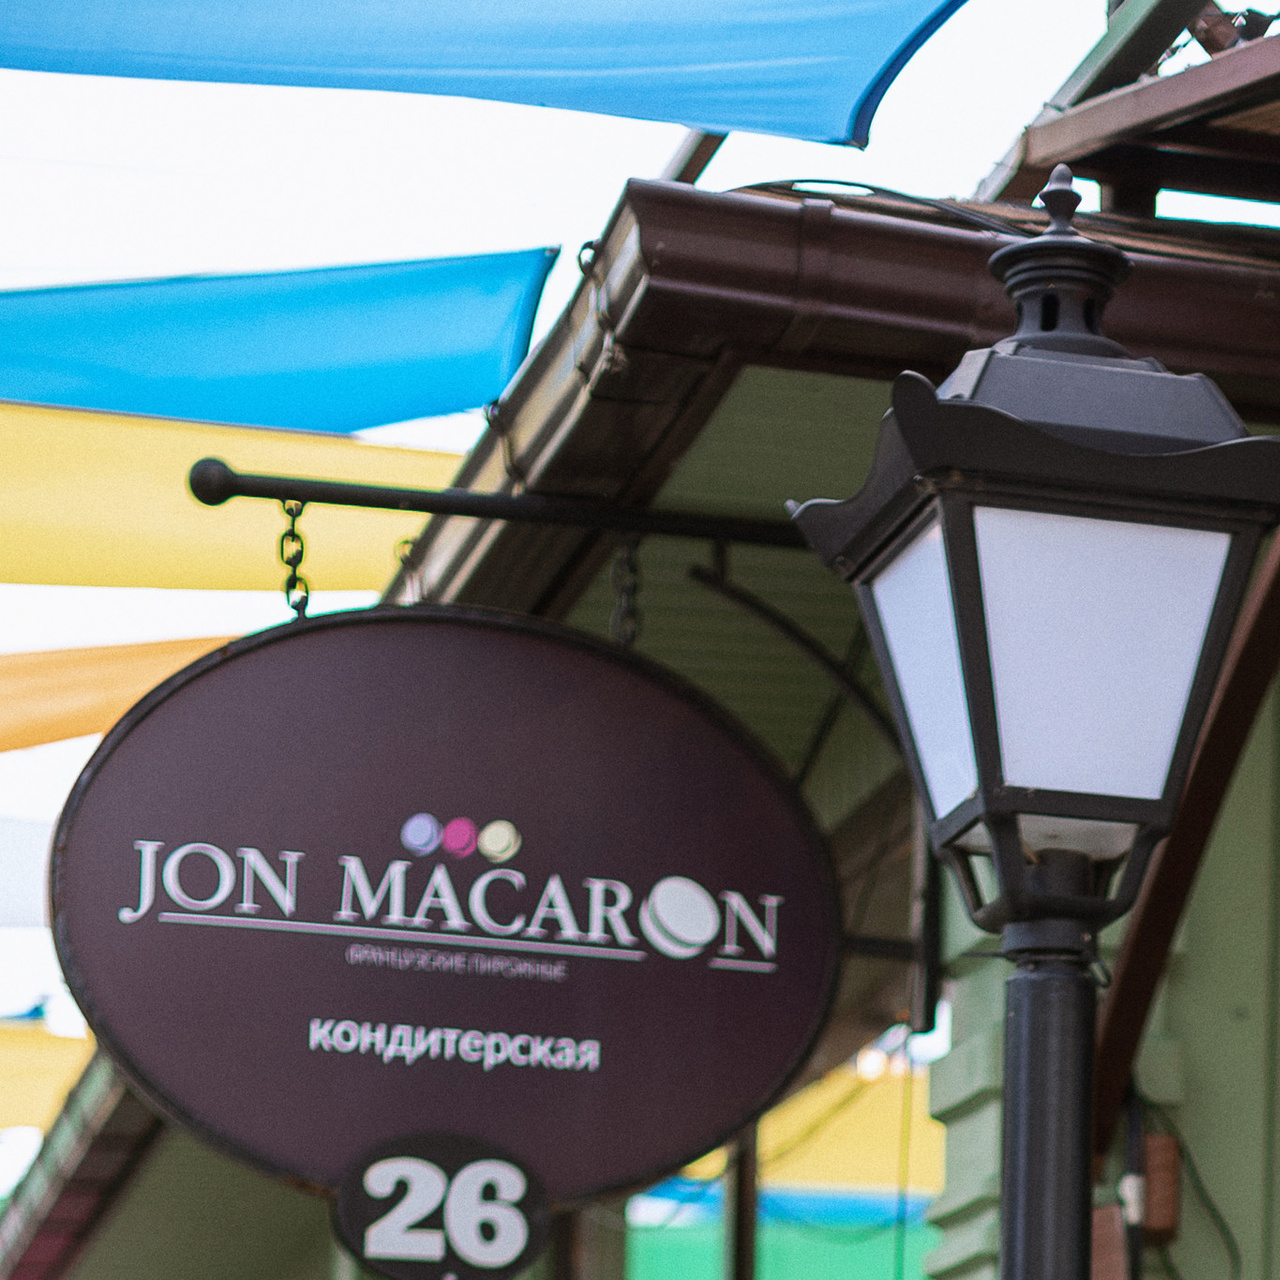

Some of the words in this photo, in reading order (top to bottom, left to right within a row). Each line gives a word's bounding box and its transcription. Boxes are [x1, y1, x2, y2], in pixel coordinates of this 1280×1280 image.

[117, 838, 306, 924] JON
[333, 854, 783, 960] MACARON
[309, 1018, 601, 1073] кондитерская
[361, 1156, 530, 1269] 26
